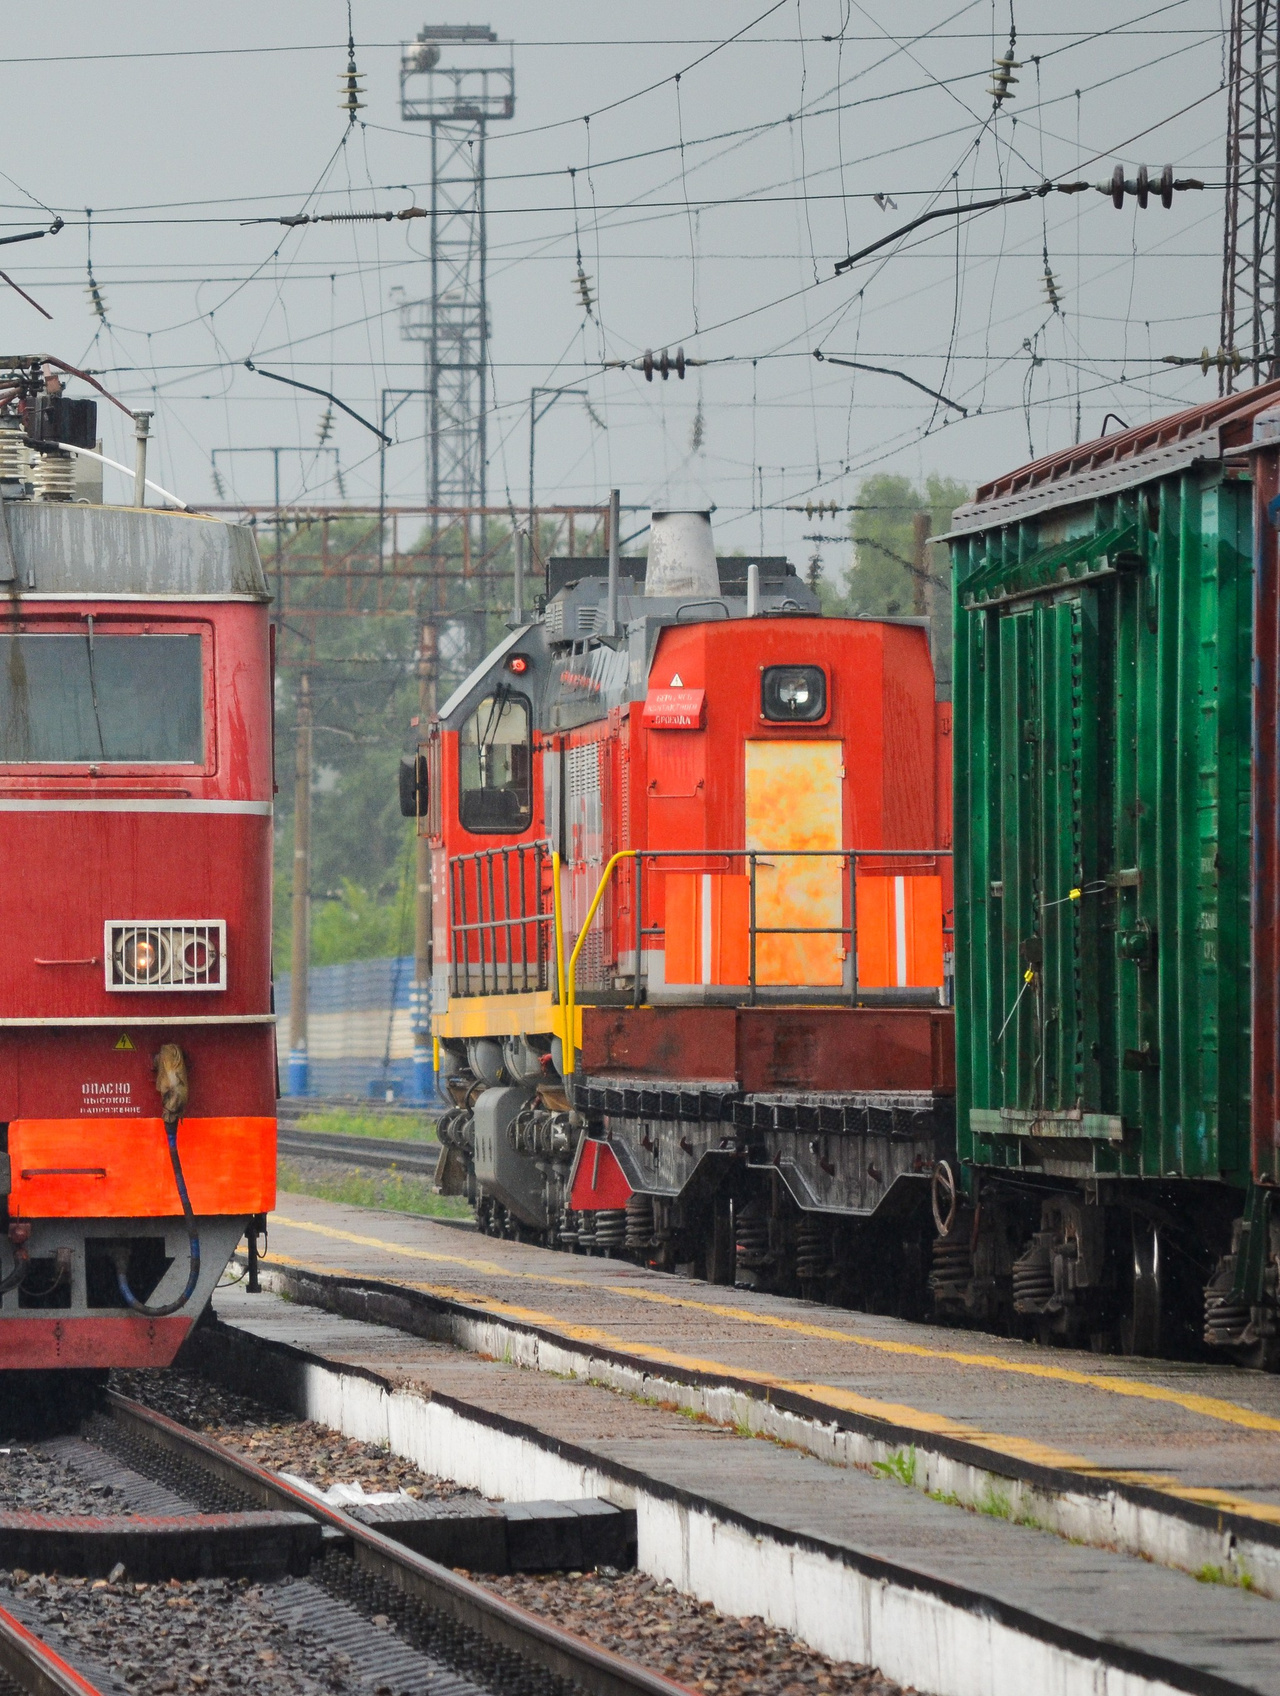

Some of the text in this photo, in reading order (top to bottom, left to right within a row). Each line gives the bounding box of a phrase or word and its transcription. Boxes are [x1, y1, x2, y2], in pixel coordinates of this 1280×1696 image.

[81, 1082, 131, 1095] ОПАСНО
[83, 1096, 132, 1105] ВЫСОКОЕ
[80, 1106, 141, 1114] НАПРЯЖЕНИЕ
